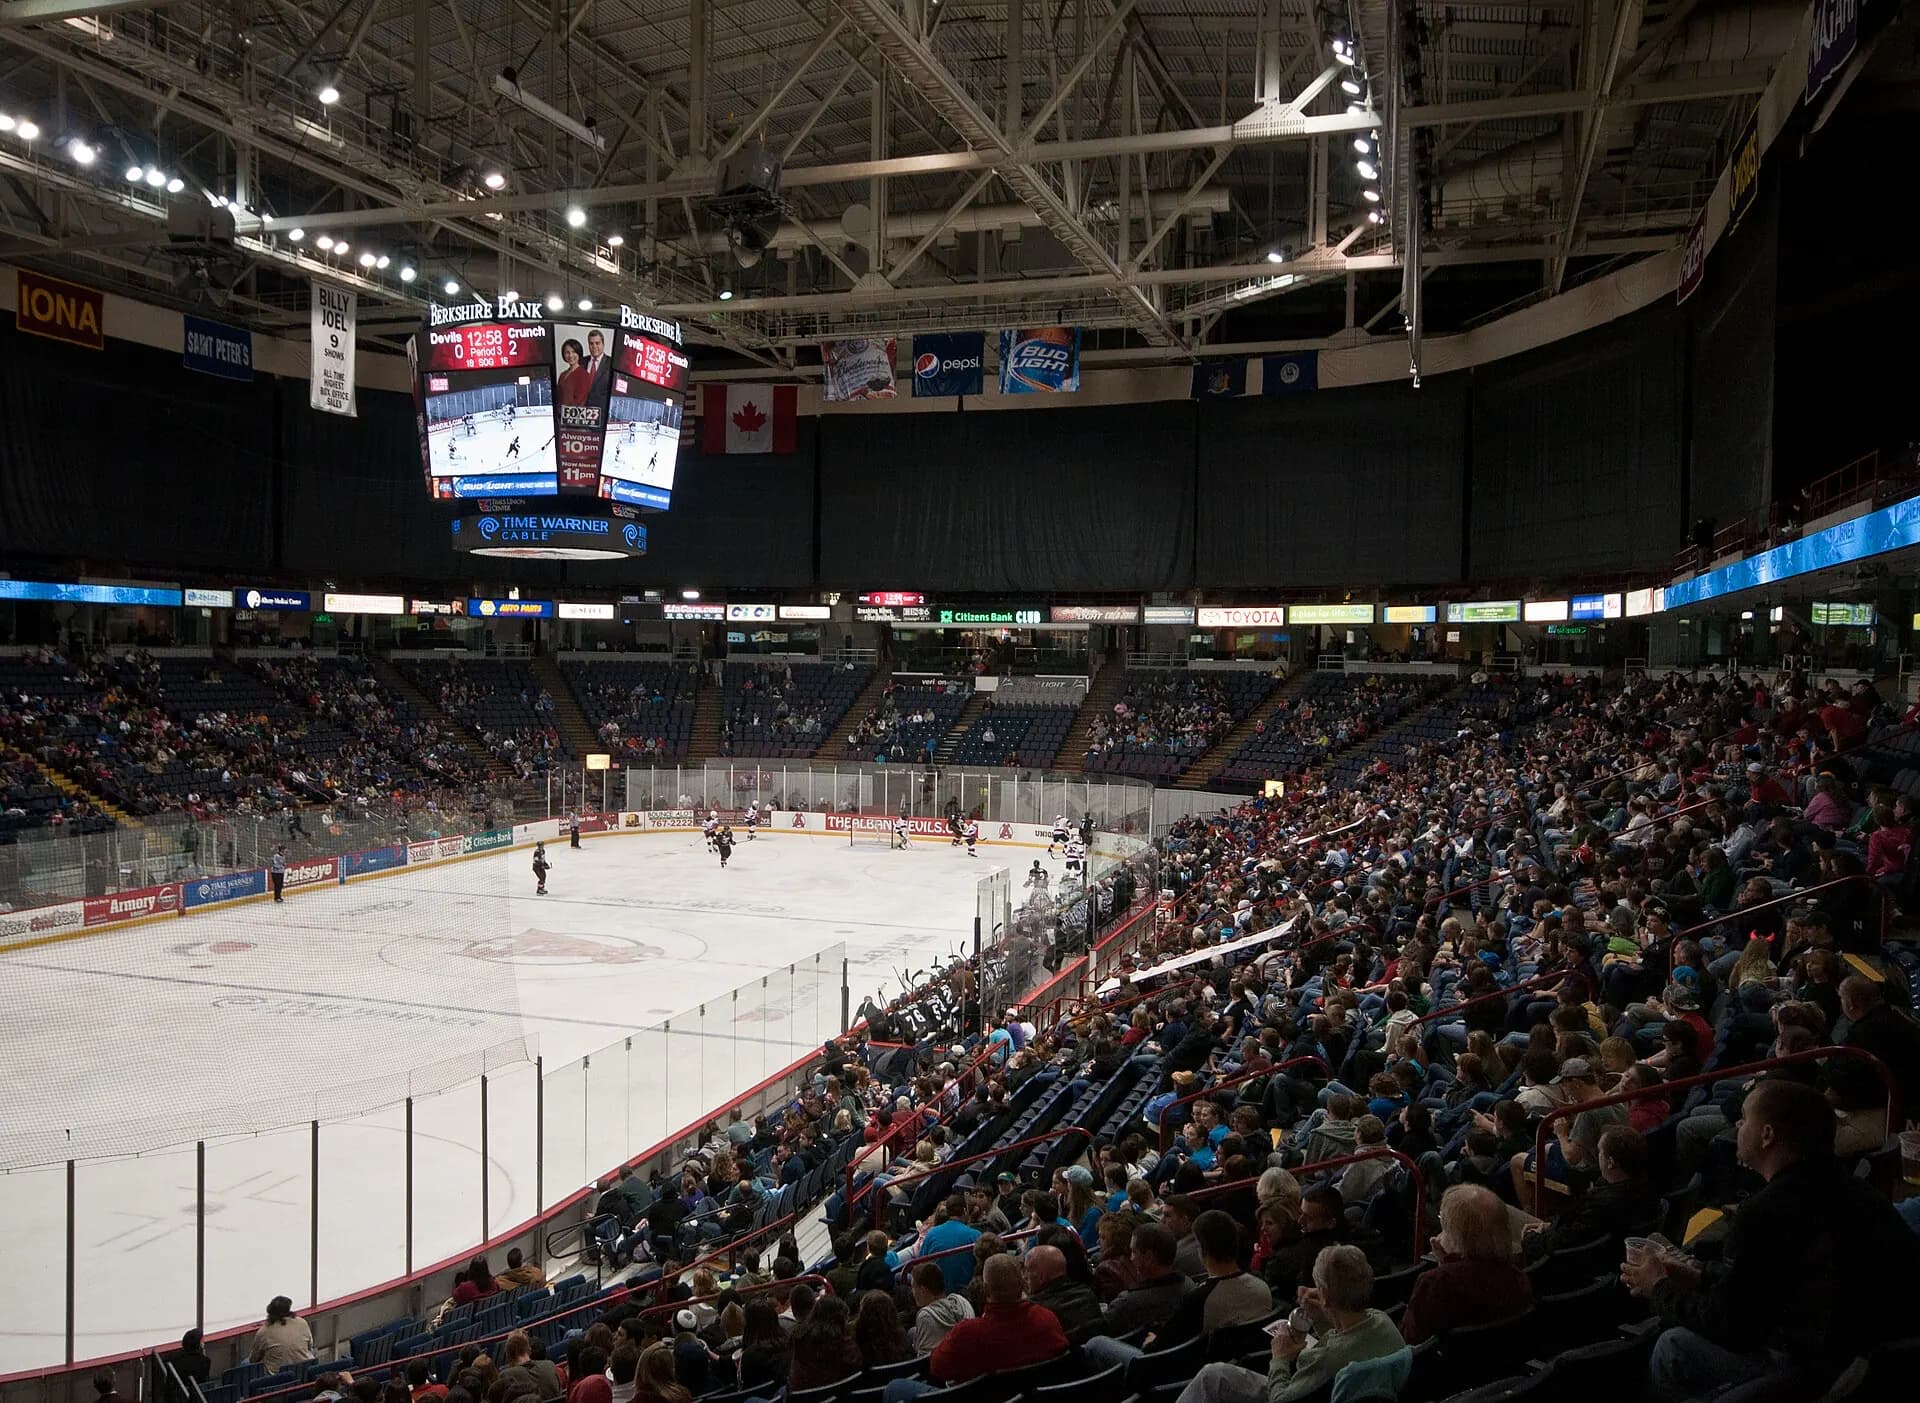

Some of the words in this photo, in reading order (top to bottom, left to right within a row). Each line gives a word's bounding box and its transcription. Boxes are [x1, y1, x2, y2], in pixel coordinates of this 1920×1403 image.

[319, 287, 349, 313] BILLY
[22, 282, 98, 336] IONA
[430, 303, 493, 326] BERKSHIRE
[497, 295, 543, 319] BANK
[322, 308, 347, 332] JOEL
[620, 304, 675, 341] BERKSHIRE
[330, 334, 339, 348] 9
[430, 331, 463, 345] Devils
[467, 330, 503, 347] 12:58
[507, 325, 546, 339] Crunch
[187, 331, 214, 358] SAINT
[215, 338, 249, 366] PETER'S
[324, 348, 344, 361] SHOWS
[454, 344, 464, 359] 0
[470, 347, 496, 357] Period
[496, 346, 503, 355] 3
[508, 340, 517, 356] 2
[646, 345, 666, 364] 12:58
[1021, 346, 1068, 361] BUD
[635, 352, 642, 367] 0
[665, 364, 672, 378] 2
[942, 356, 979, 373] pepsi
[1012, 357, 1069, 372] LIGHT
[324, 379, 344, 391] HIGHEST
[332, 389, 349, 401] OFFICE
[564, 407, 585, 419] FOX
[586, 408, 599, 420] 23
[561, 433, 592, 443] Always
[502, 517, 537, 529] TIME
[502, 531, 549, 541] CABLE
[955, 612, 989, 622] Citizens
[990, 612, 1013, 622] Bank
[1015, 611, 1041, 623] CLUB
[1224, 611, 1280, 623] TOYOTA
[651, 819, 693, 828] 767-2222
[473, 836, 496, 848] Citizens
[497, 831, 511, 842] Bank
[210, 881, 227, 890] TIME
[110, 896, 156, 915] Armory
